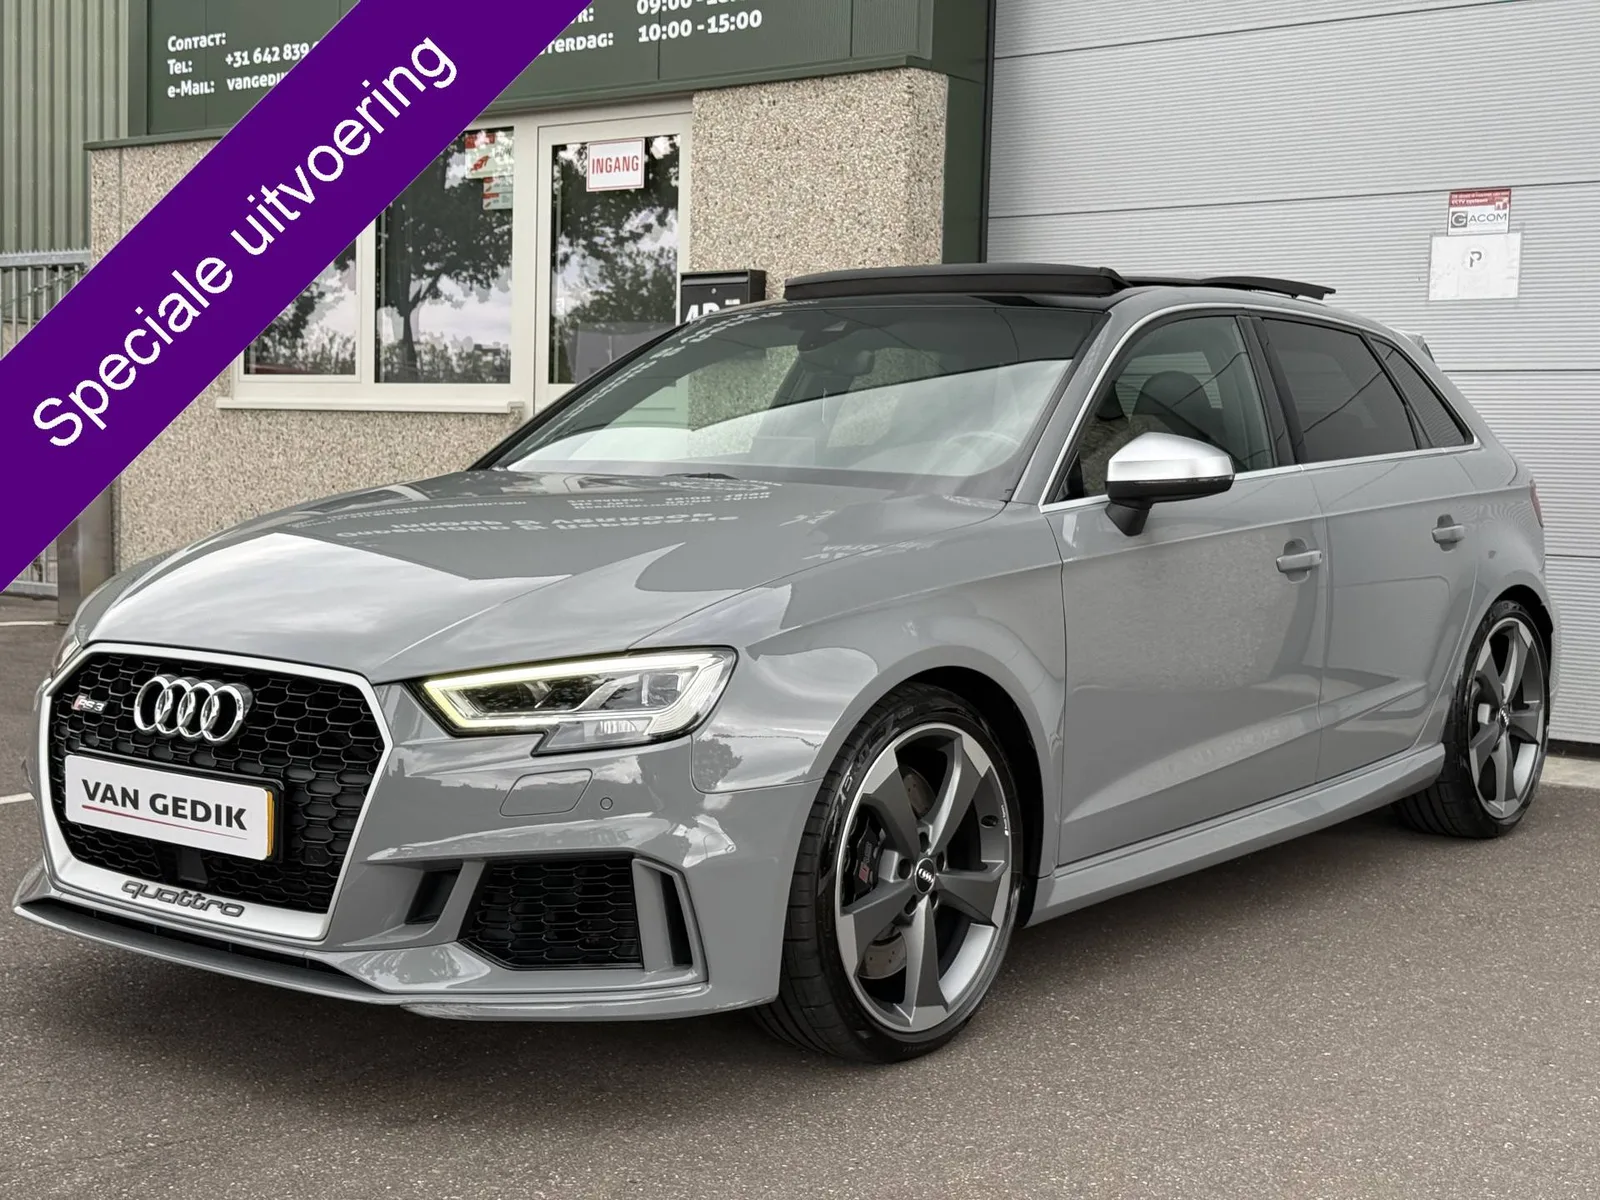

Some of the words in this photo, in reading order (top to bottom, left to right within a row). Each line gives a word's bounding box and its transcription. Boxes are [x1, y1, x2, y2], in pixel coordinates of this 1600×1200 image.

[167, 32, 226, 52] Contact:
[540, 32, 614, 55] terdag:
[638, 20, 692, 42] 10:00
[707, 10, 762, 34] 15:00
[167, 59, 193, 75] Tel:
[225, 50, 251, 68] +31
[253, 46, 281, 65] 642
[282, 42, 310, 61] 839
[167, 79, 215, 98] e-Mail:
[226, 71, 290, 91] vangedi
[591, 155, 639, 175] INGANG
[1450, 211, 1507, 228] GACOM
[81, 778, 140, 811] VAN
[149, 793, 248, 831] GEDIK
[121, 879, 246, 918] quattro
